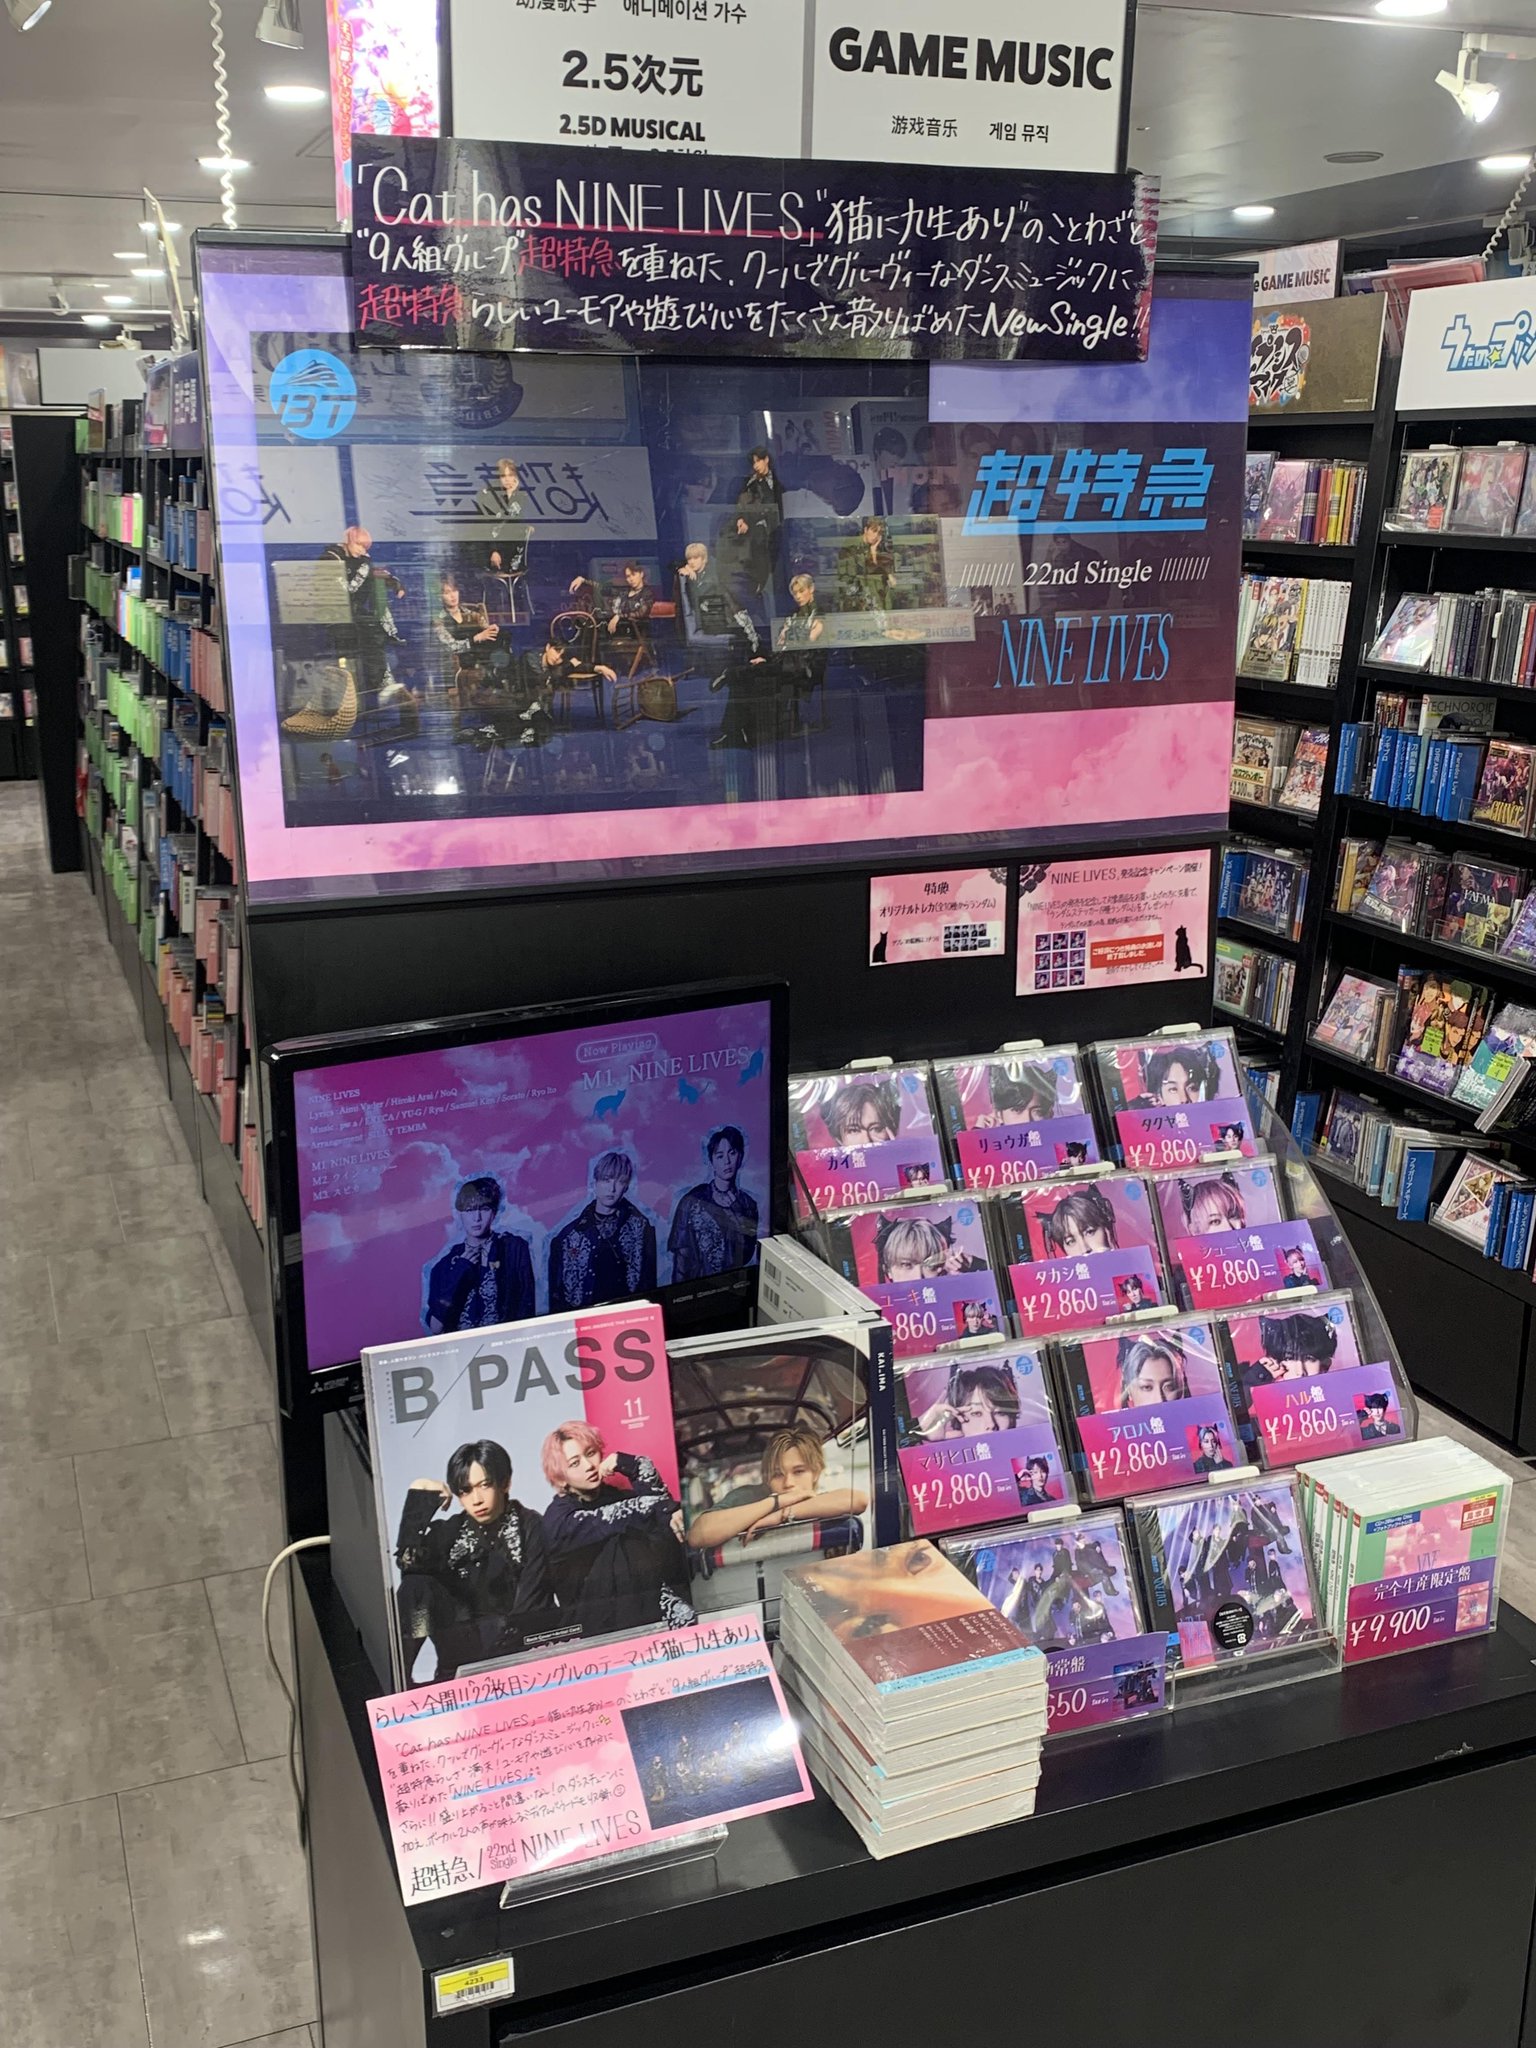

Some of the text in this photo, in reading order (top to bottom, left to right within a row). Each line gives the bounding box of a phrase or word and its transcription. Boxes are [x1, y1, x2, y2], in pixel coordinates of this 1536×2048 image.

[714, 3, 747, 25] 가수
[829, 27, 1115, 91] GAME MUSIC
[562, 49, 703, 98] 2.5次元
[559, 114, 706, 143] 2.5D MUSICAL
[891, 115, 958, 138] 游戏音乐
[989, 122, 1049, 144] 게임 뮤직
[472, 170, 542, 228] has
[556, 178, 664, 233] NINE
[1261, 273, 1294, 291] GAME
[1295, 268, 1331, 288] MUSIC
[961, 448, 1215, 537] 超特急
[1022, 559, 1153, 589] 22nd Single
[993, 616, 1082, 689] NINE
[1083, 612, 1174, 684] LIVES
[583, 1038, 652, 1058] Now Playing
[629, 1058, 684, 1083] NINE
[688, 1046, 750, 1074] LIVES
[334, 1088, 361, 1102] LIVES
[1141, 1112, 1190, 1132] タクヤ盤
[979, 1130, 1042, 1154] リョウガ盤
[359, 1150, 390, 1164] LIVES
[1202, 1234, 1265, 1260] シューヤ盤
[1035, 1262, 1091, 1287] タカシ盤
[624, 1397, 643, 1418] 11
[1285, 1385, 1326, 1408] ハル盤
[1107, 1416, 1166, 1443] アロハ盤
[919, 1442, 991, 1472] マサヒロ盤
[1373, 1565, 1471, 1602] 完全生産限定盤
[454, 1726, 491, 1743] NINE
[490, 1852, 518, 1870] Single
[464, 1976, 484, 1986] 4233
